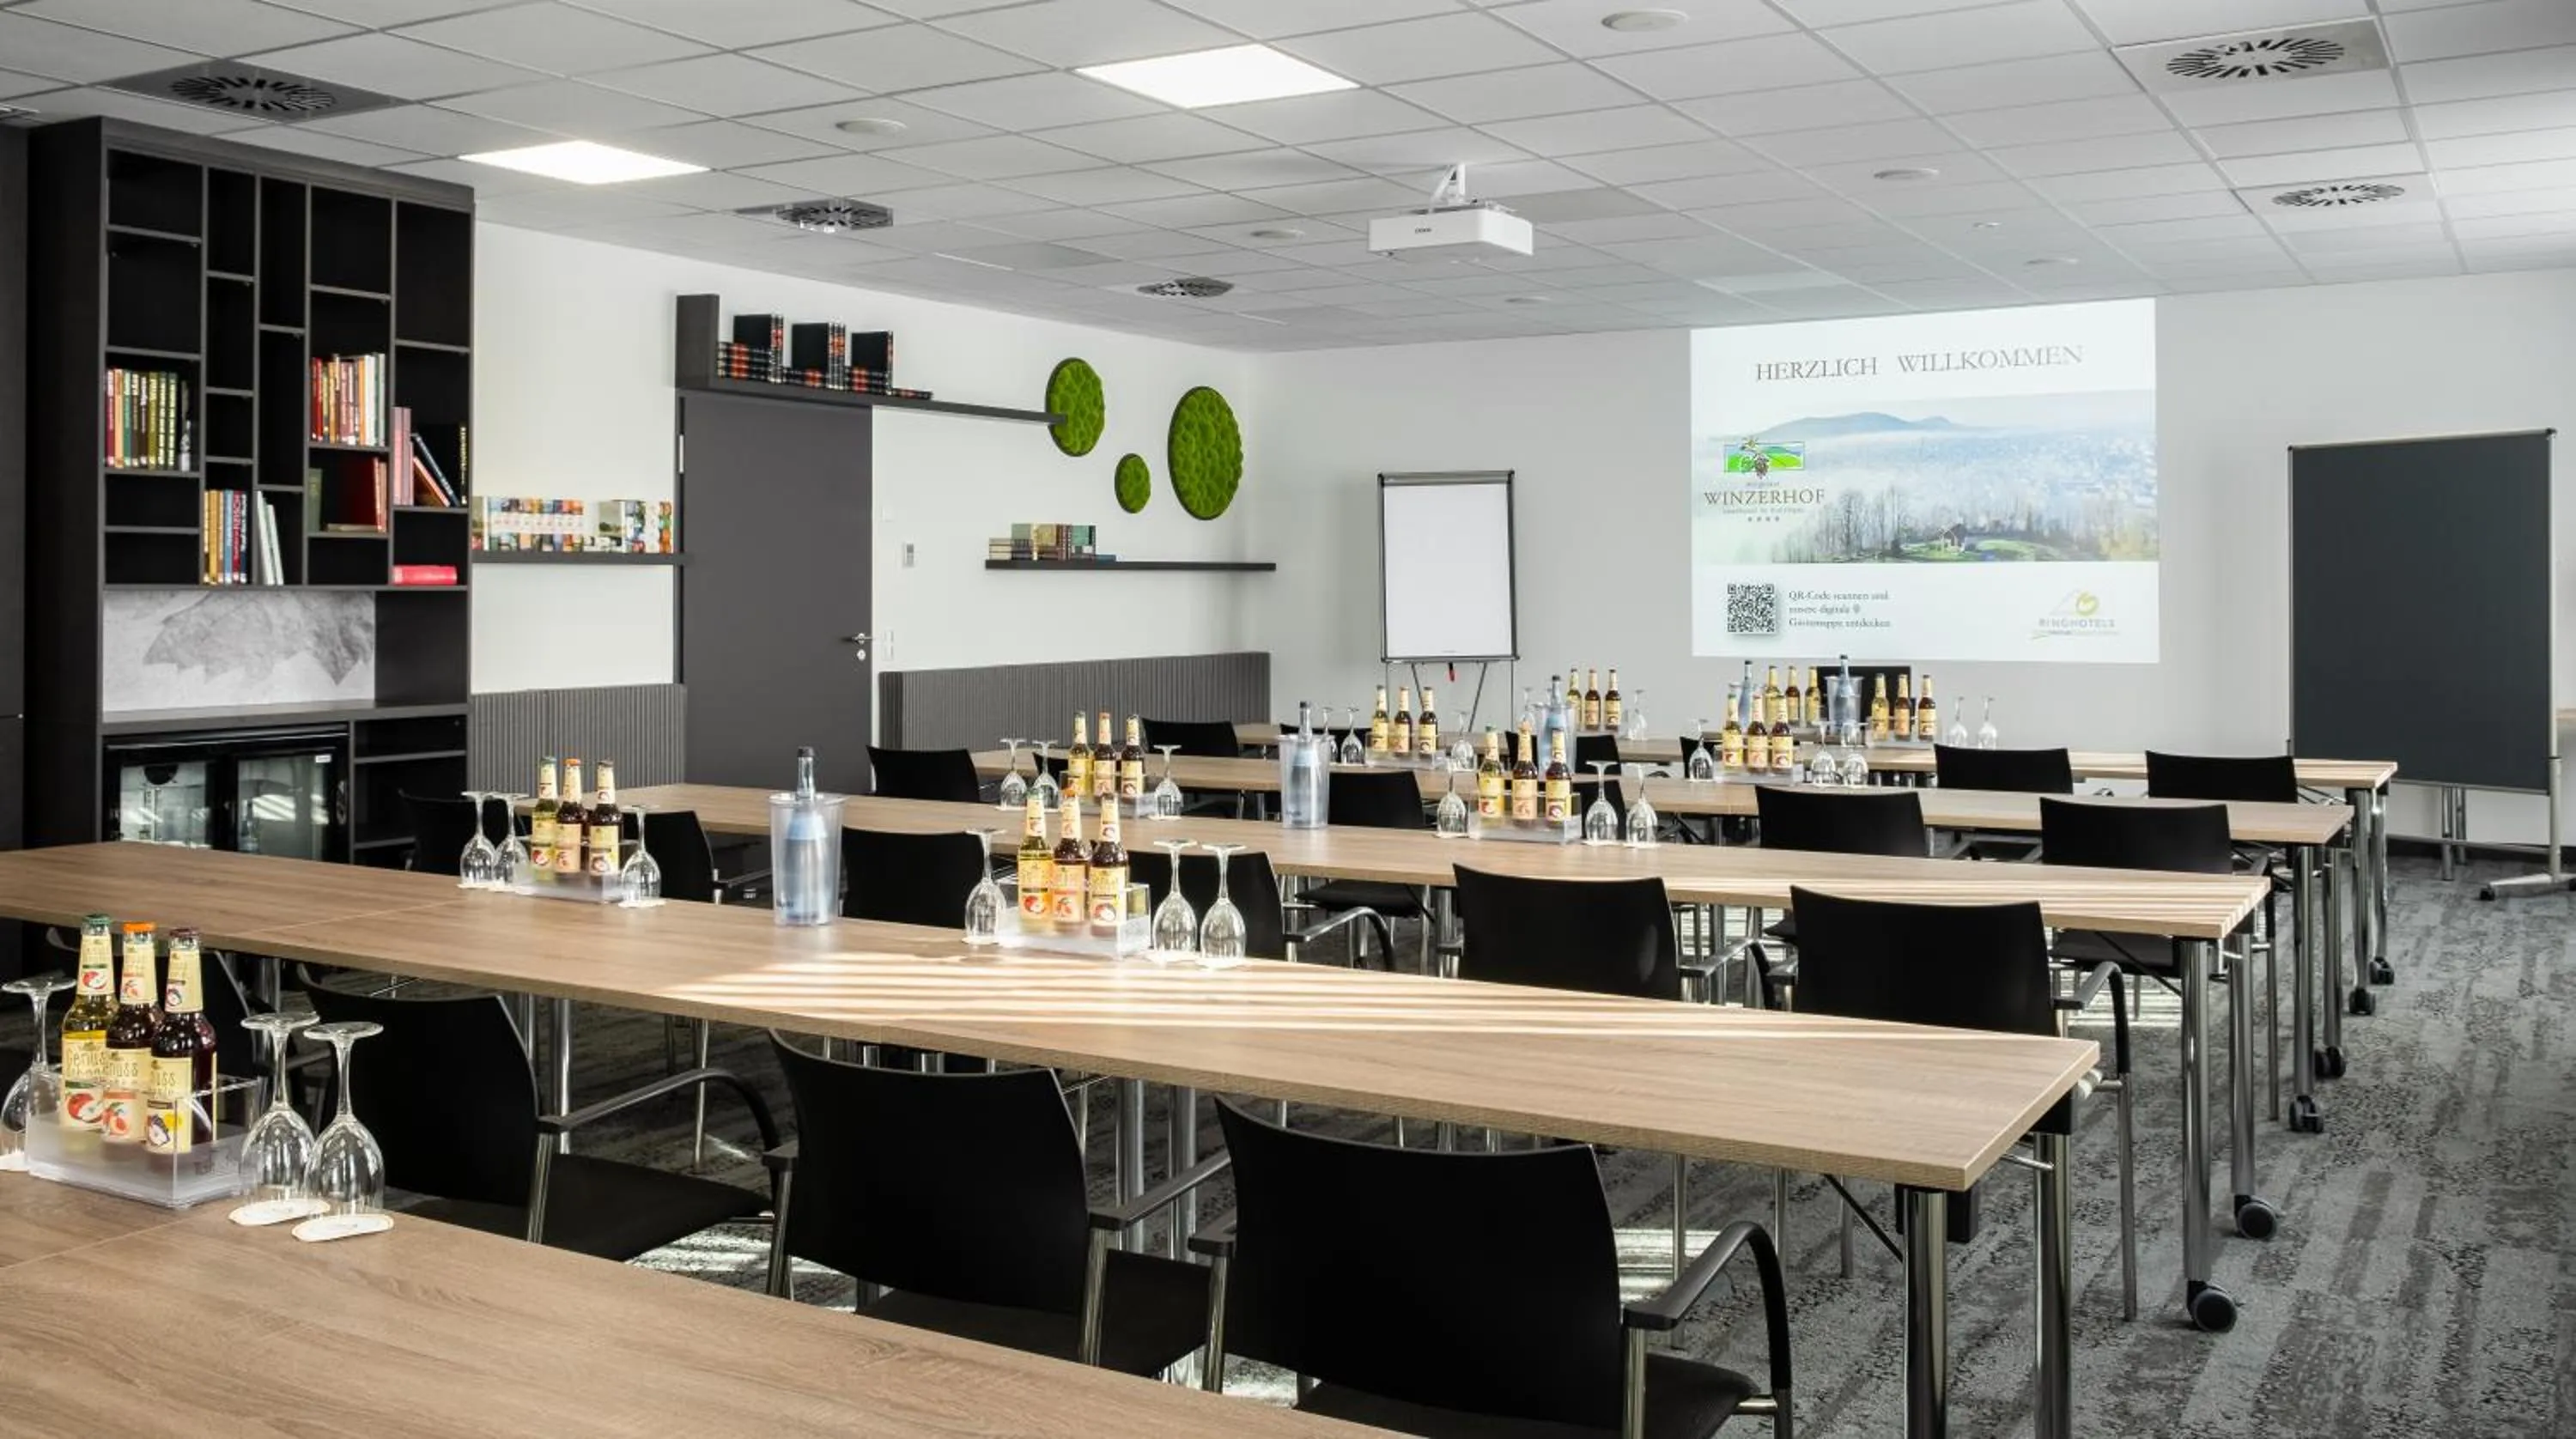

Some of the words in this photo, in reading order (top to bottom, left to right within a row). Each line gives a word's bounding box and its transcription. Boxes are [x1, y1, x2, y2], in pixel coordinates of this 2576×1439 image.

[1756, 356, 1878, 382] HERZLICH
[1897, 344, 2084, 373] WILLKOMMEN
[1704, 488, 1826, 506] WINZERHOF
